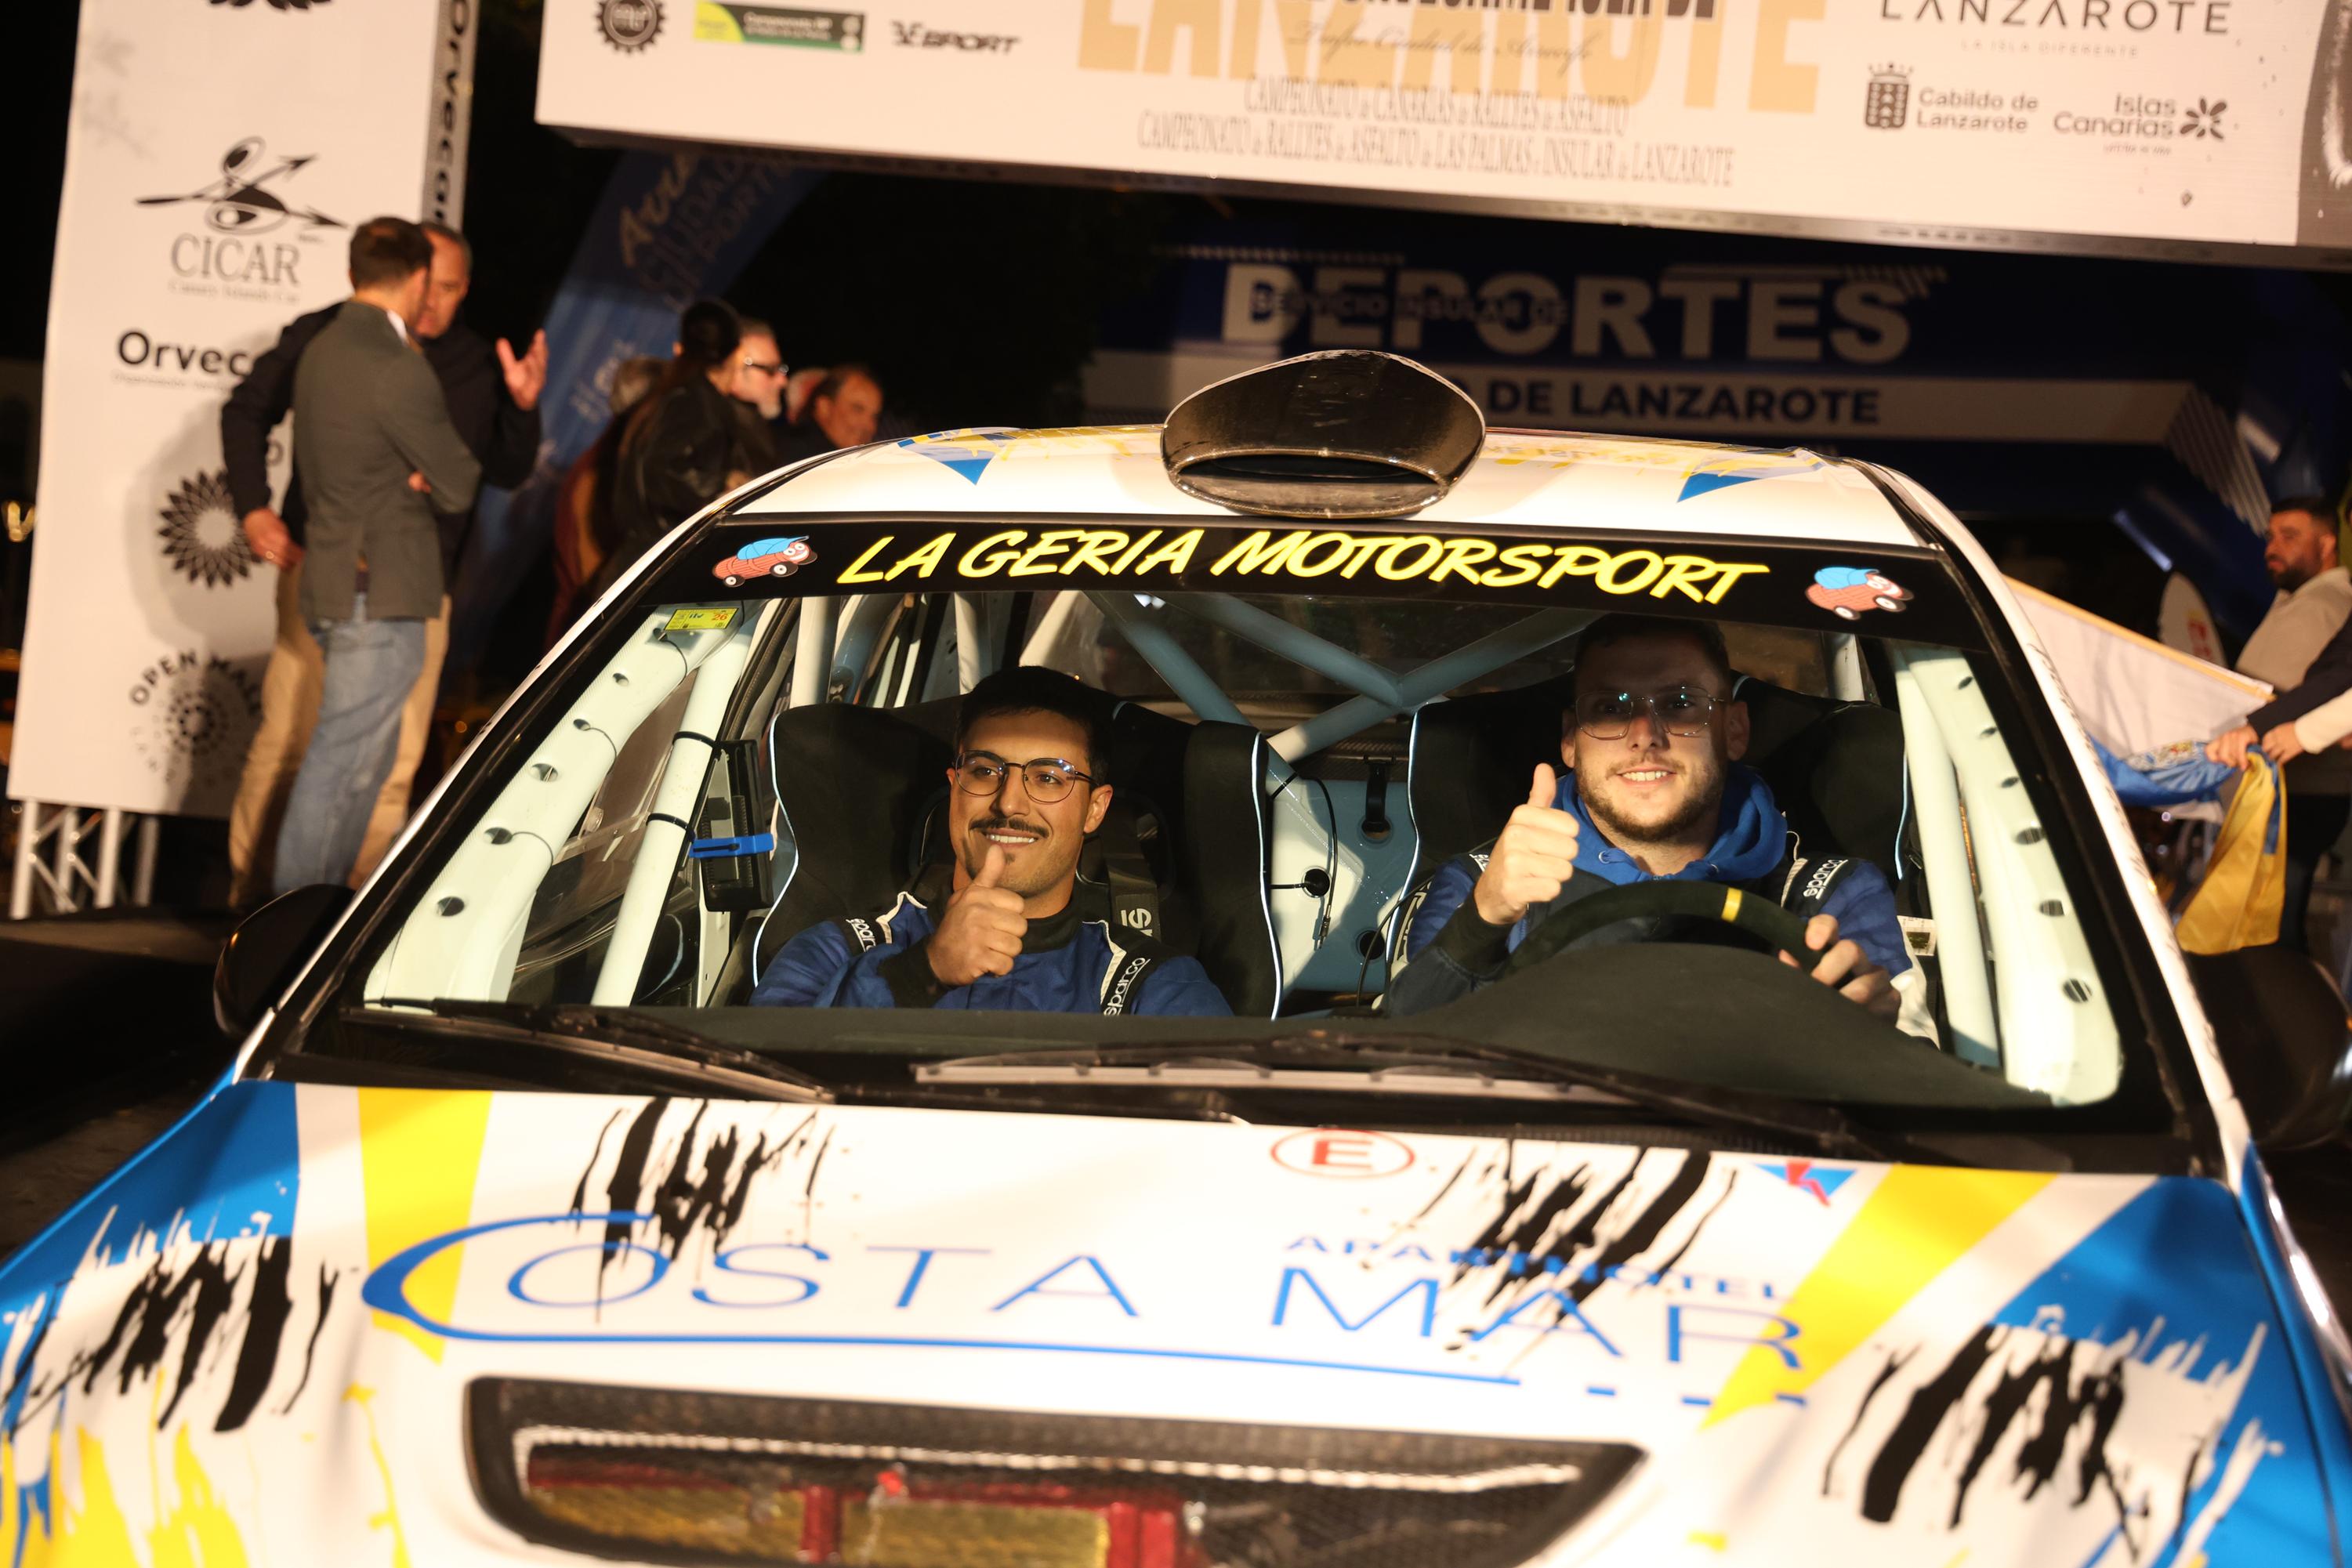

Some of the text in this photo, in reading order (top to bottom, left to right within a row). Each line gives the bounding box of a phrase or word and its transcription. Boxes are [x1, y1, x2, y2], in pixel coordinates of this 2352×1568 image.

[1881, 0, 2232, 33] LANZAROTE
[1917, 110, 2028, 132] Lanzarote
[1919, 87, 2039, 111] Cabildo de
[2115, 94, 2176, 117] Islas
[2053, 111, 2176, 139] Canarias
[170, 232, 301, 287] CICAR
[1220, 262, 1912, 364] DEPORTES
[118, 330, 250, 376] Orvec
[1488, 379, 1880, 424] DE LANZAROTE
[836, 530, 1770, 604] LA GERIA MOTORSPORT
[129, 650, 198, 705] OPEN
[1803, 859, 1846, 899] sparco
[849, 918, 876, 951] spar
[1104, 957, 1149, 1016] sparco
[1311, 1136, 1376, 1167] E
[362, 1210, 1139, 1342] COSTA
[1271, 1266, 1803, 1371] MAR
